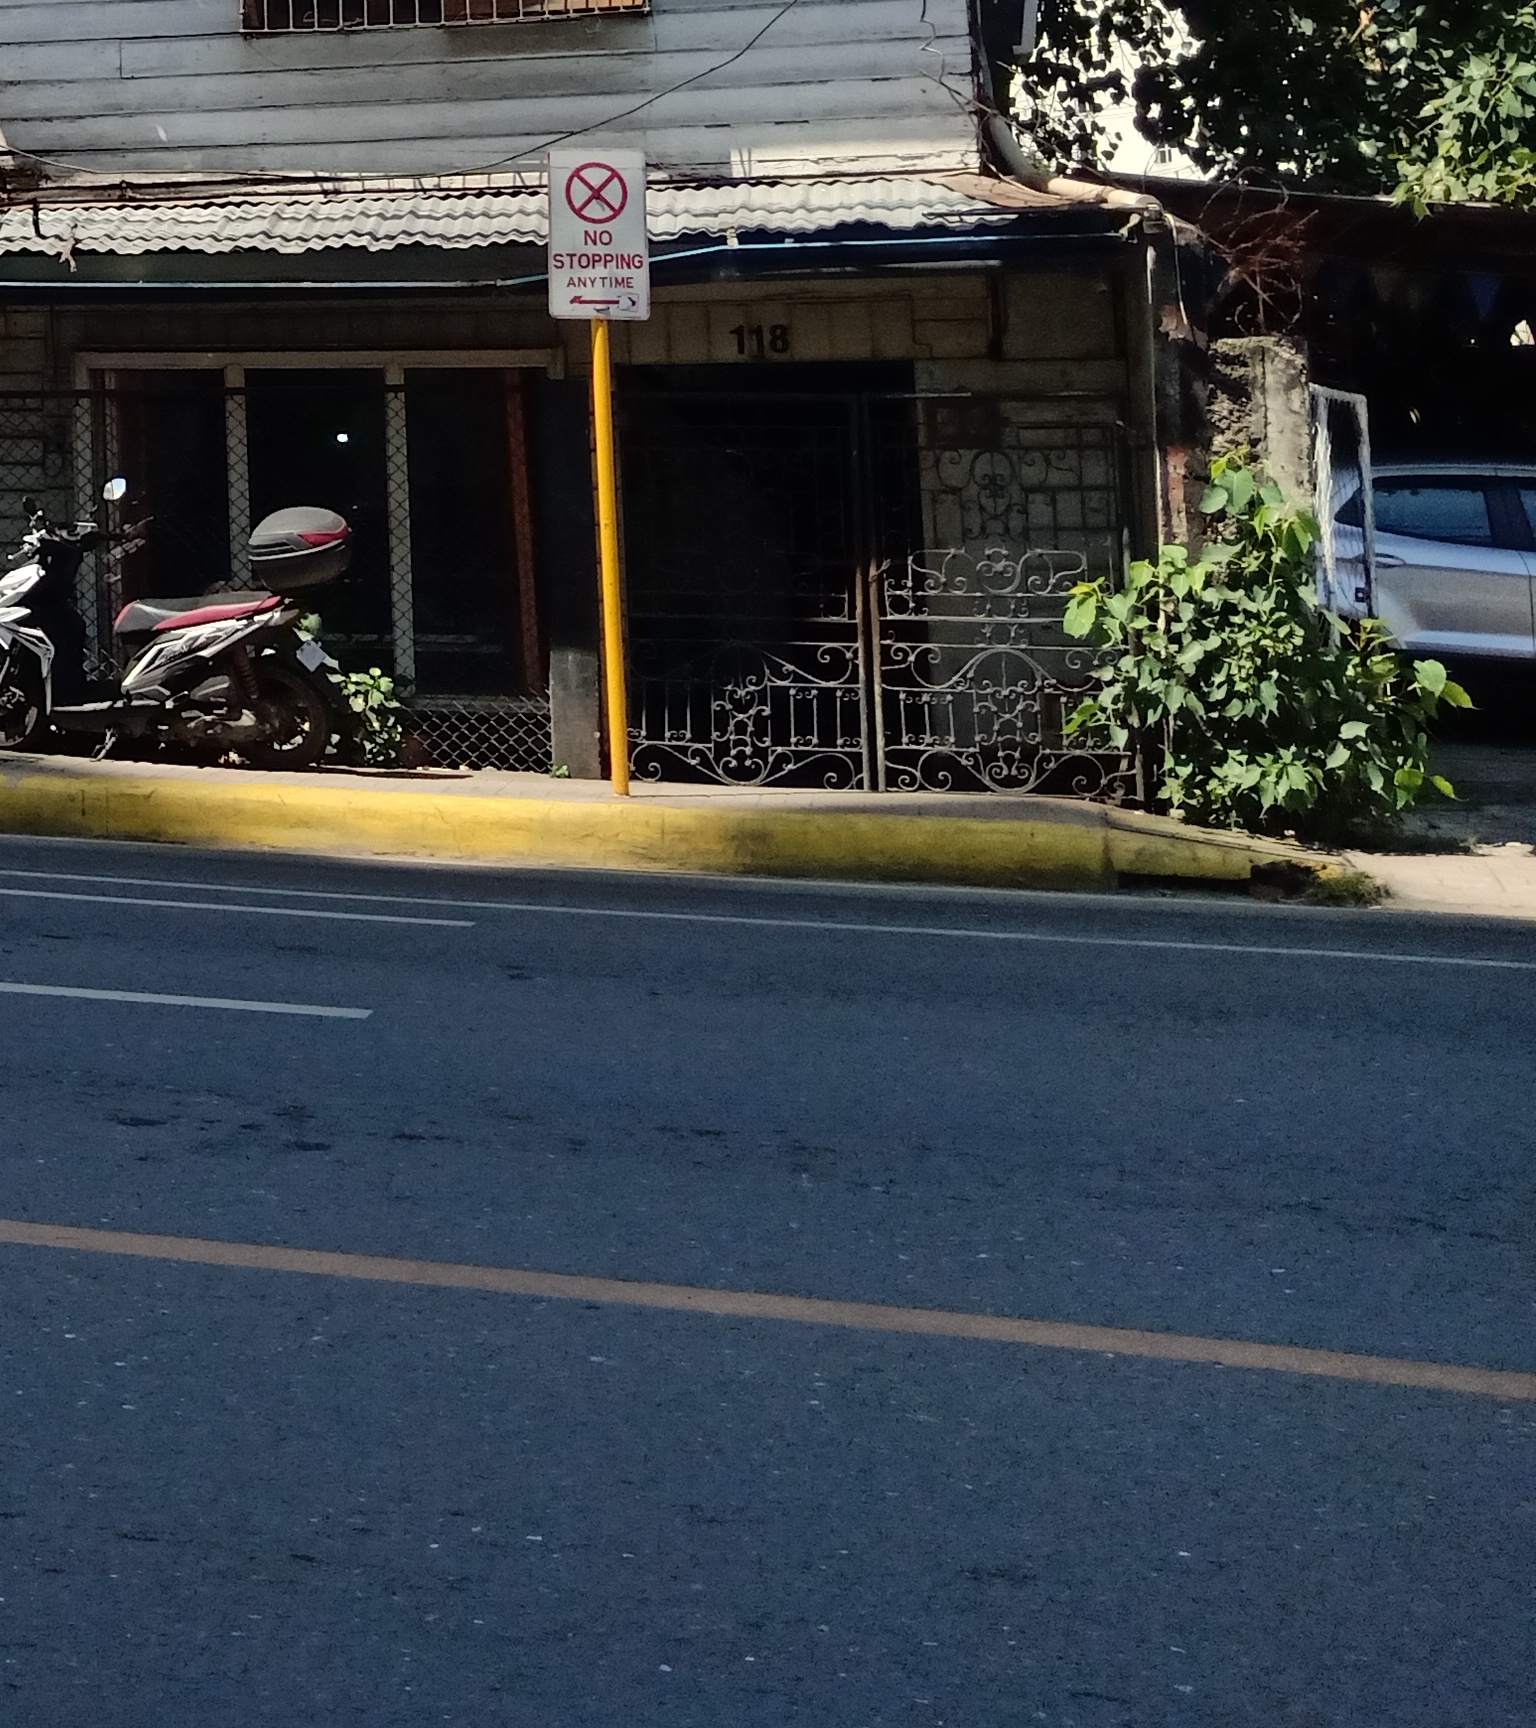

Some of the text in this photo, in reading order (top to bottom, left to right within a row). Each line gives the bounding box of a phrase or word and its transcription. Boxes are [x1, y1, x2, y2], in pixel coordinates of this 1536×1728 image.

[583, 229, 614, 247] NO
[552, 252, 645, 271] STOPPING
[565, 275, 635, 290] ANYTIME
[729, 323, 790, 356] 118
